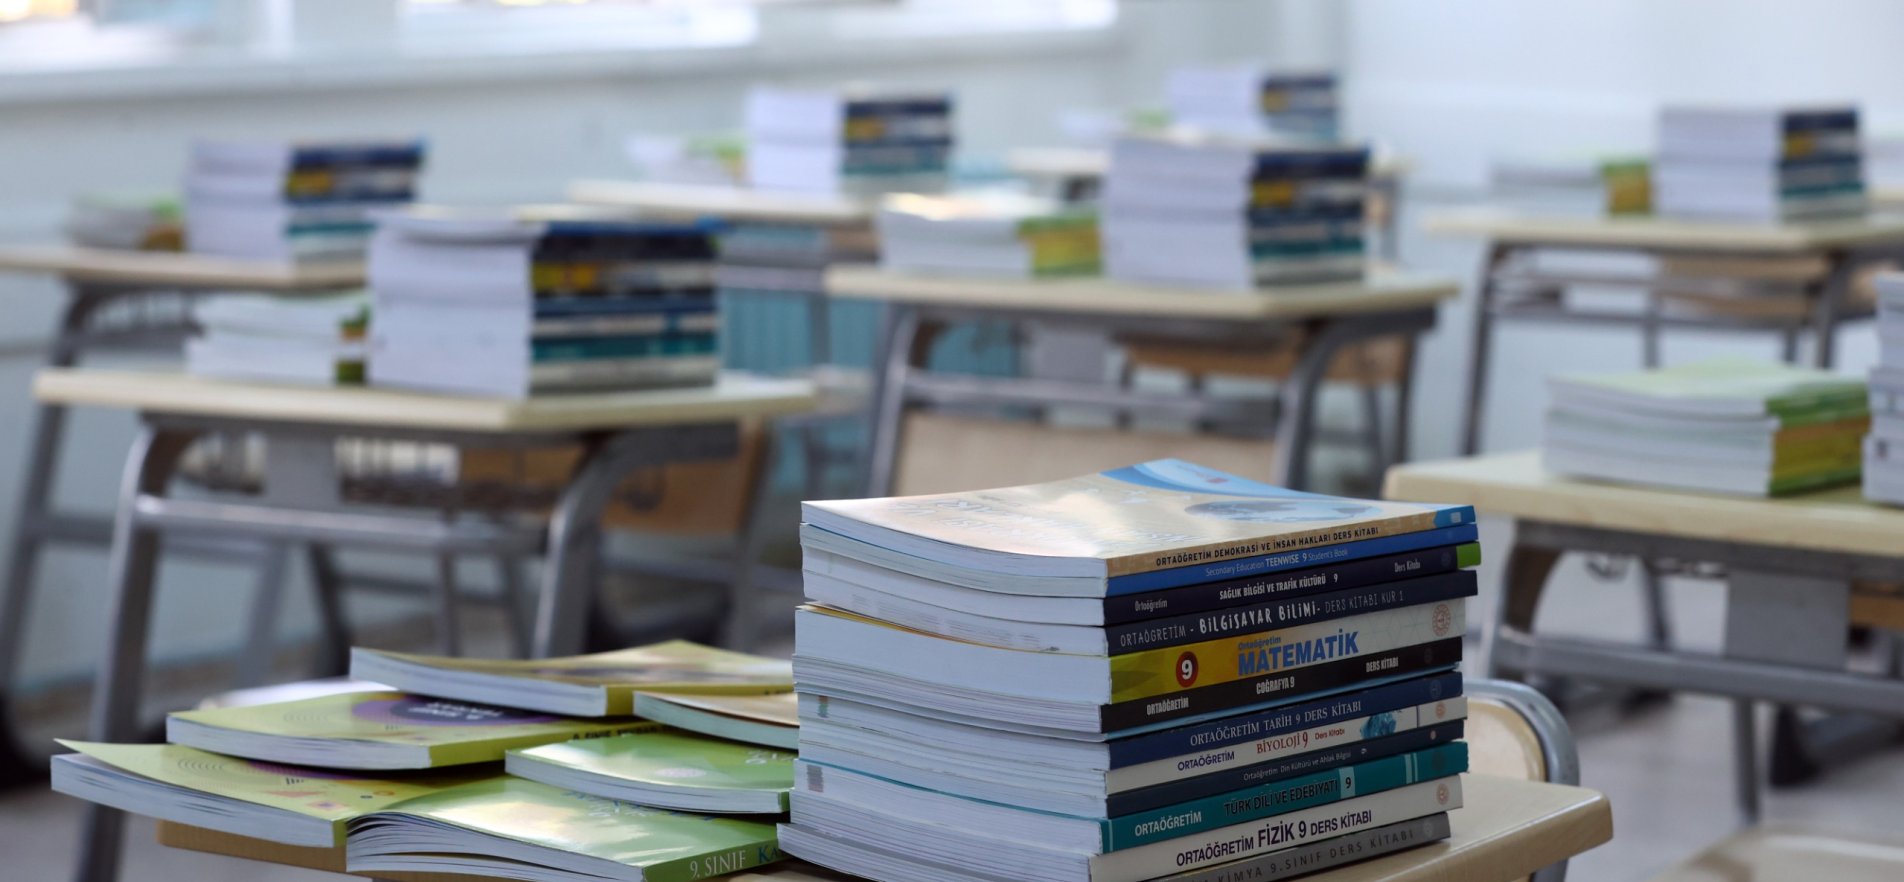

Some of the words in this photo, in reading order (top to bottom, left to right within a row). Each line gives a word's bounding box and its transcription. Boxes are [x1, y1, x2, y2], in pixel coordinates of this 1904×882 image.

[1214, 544, 1259, 558] DEMOKRASİ
[1261, 542, 1271, 551] VE
[1273, 537, 1296, 549] İNSAN
[1298, 534, 1331, 545] HAKLARI
[1333, 530, 1352, 541] DERS
[1354, 527, 1379, 538] KİTABI
[1206, 564, 1235, 577] Secondary
[1236, 562, 1264, 572] Education
[1265, 554, 1299, 567] TEENWISE
[1302, 554, 1308, 562] 9
[1334, 549, 1348, 557] Book
[1219, 588, 1242, 600] SAĞLIK
[1243, 582, 1265, 596] BİLGİSİ
[1266, 583, 1275, 593] VE
[1276, 578, 1298, 592] TRAFİK
[1299, 575, 1326, 588] KÜLTÜRÜ
[1333, 573, 1339, 583] 9
[1325, 598, 1346, 613] DERS
[1349, 594, 1378, 609] KİTABI
[1381, 591, 1397, 603] KUR
[1181, 659, 1193, 680] 9
[1238, 629, 1359, 676] MATEMATİK
[1146, 697, 1189, 715] ORTAÖĞRETİM
[1256, 678, 1290, 695] COĞRAFYA
[1290, 676, 1295, 688] 9
[1366, 661, 1380, 672] DERS
[1381, 657, 1399, 670] KİTABI
[1190, 721, 1260, 746] ORTAÖĞRETİM
[1263, 714, 1292, 731] TARİH
[1295, 714, 1301, 724] 9
[1304, 708, 1328, 722] DERS
[1332, 701, 1361, 716] KİTABI
[1178, 751, 1235, 771] ORTAÖĞRETİM
[1257, 732, 1300, 754] BİYOLOJİ
[1302, 732, 1308, 748] 9
[1315, 730, 1328, 740] Ders
[1280, 764, 1290, 773] Din
[1320, 754, 1336, 764] Ahlak
[1134, 811, 1202, 837] ORTAÖĞRETİM
[1273, 790, 1287, 804] VE
[1345, 777, 1352, 789] 9
[1176, 835, 1254, 867] ORTAÖĞRETİM
[1257, 820, 1295, 848] FİZİK
[1298, 821, 1307, 838] 9
[1310, 818, 1338, 836] DERS
[1340, 810, 1372, 830] KİTABI
[1218, 866, 1262, 882] KİMYA
[1330, 842, 1362, 858] DERS
[1370, 830, 1414, 847] KİTABI
[704, 850, 747, 877] SINIF
